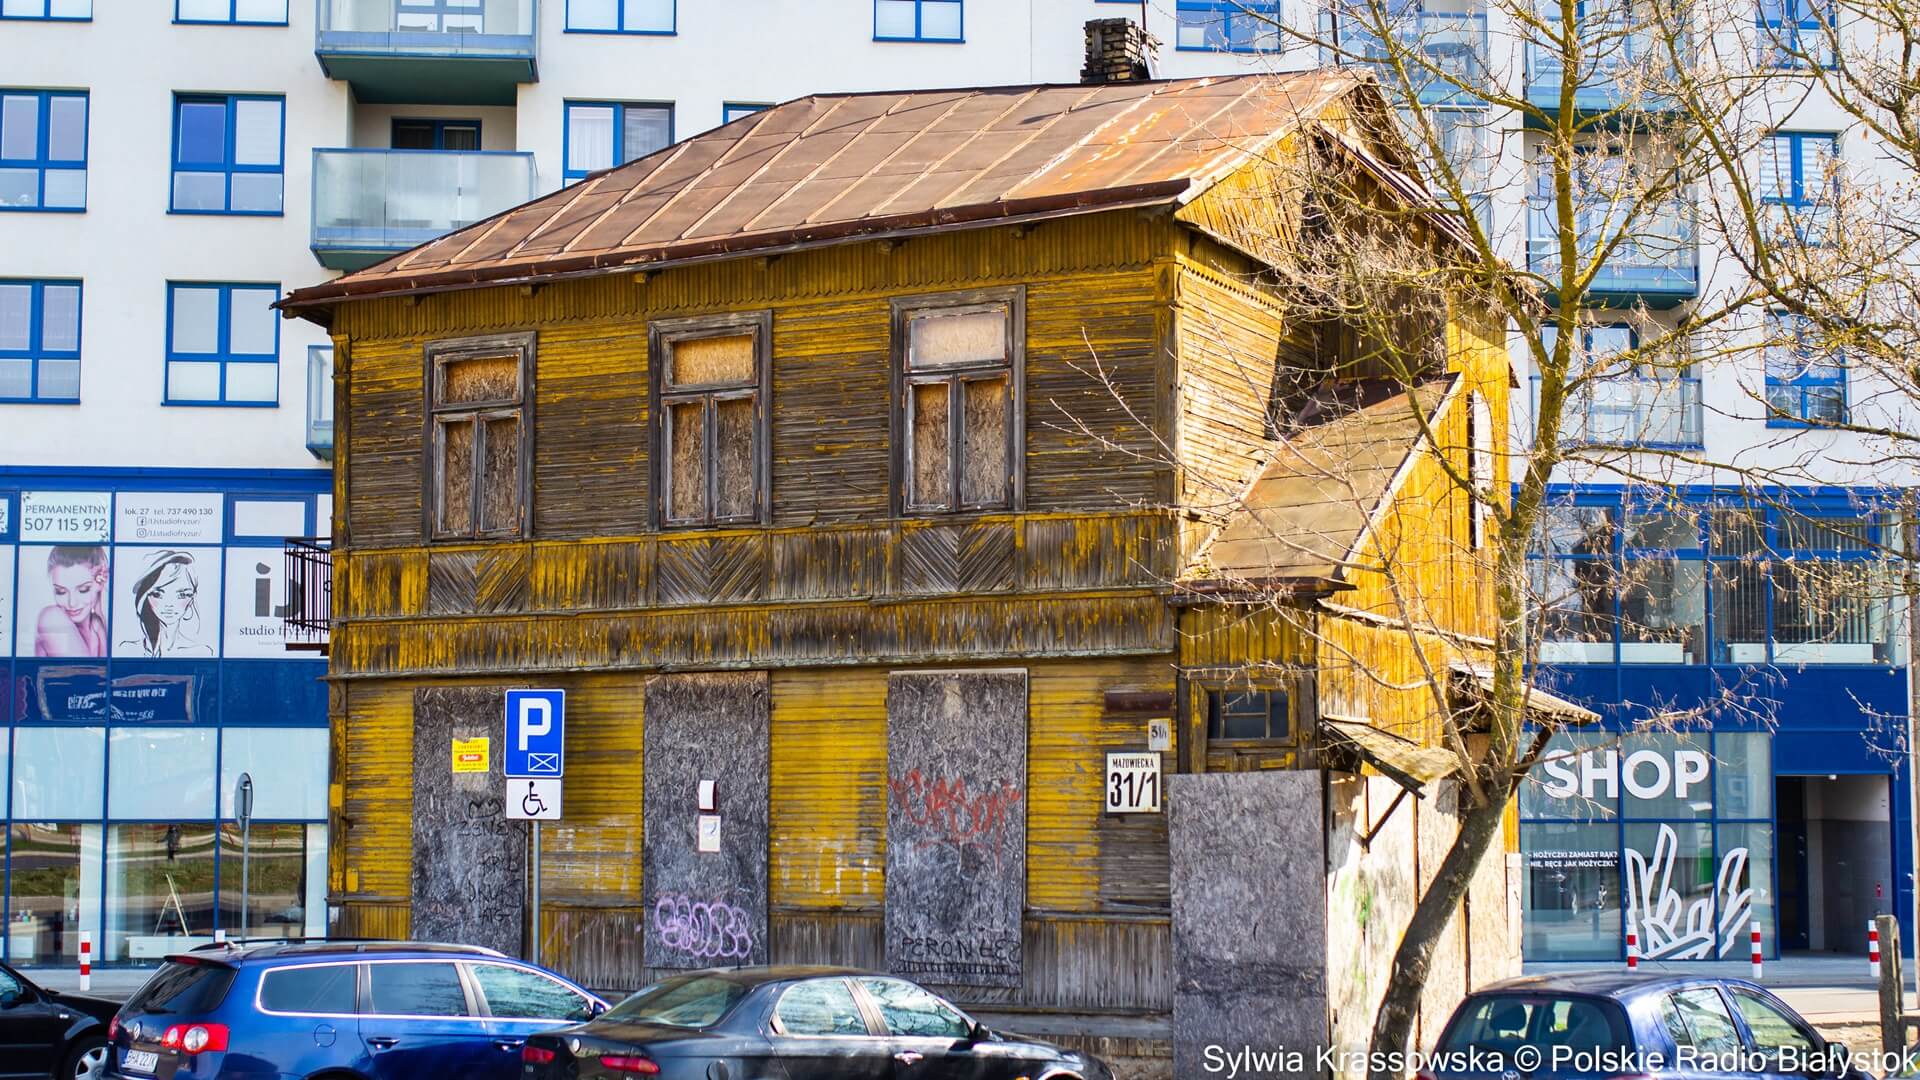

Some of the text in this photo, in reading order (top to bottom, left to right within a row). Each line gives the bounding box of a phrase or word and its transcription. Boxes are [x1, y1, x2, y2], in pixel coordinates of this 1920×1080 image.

[25, 504, 107, 515] PERMANENTNY
[24, 518, 107, 531] 507 115 912
[240, 625, 275, 636] studio
[518, 698, 552, 751] P
[1112, 758, 1155, 769] MAZOWIECKA
[1542, 749, 1710, 799] SHOP
[1110, 771, 1158, 808] 31/1
[1569, 850, 1599, 858] ZAMIAST
